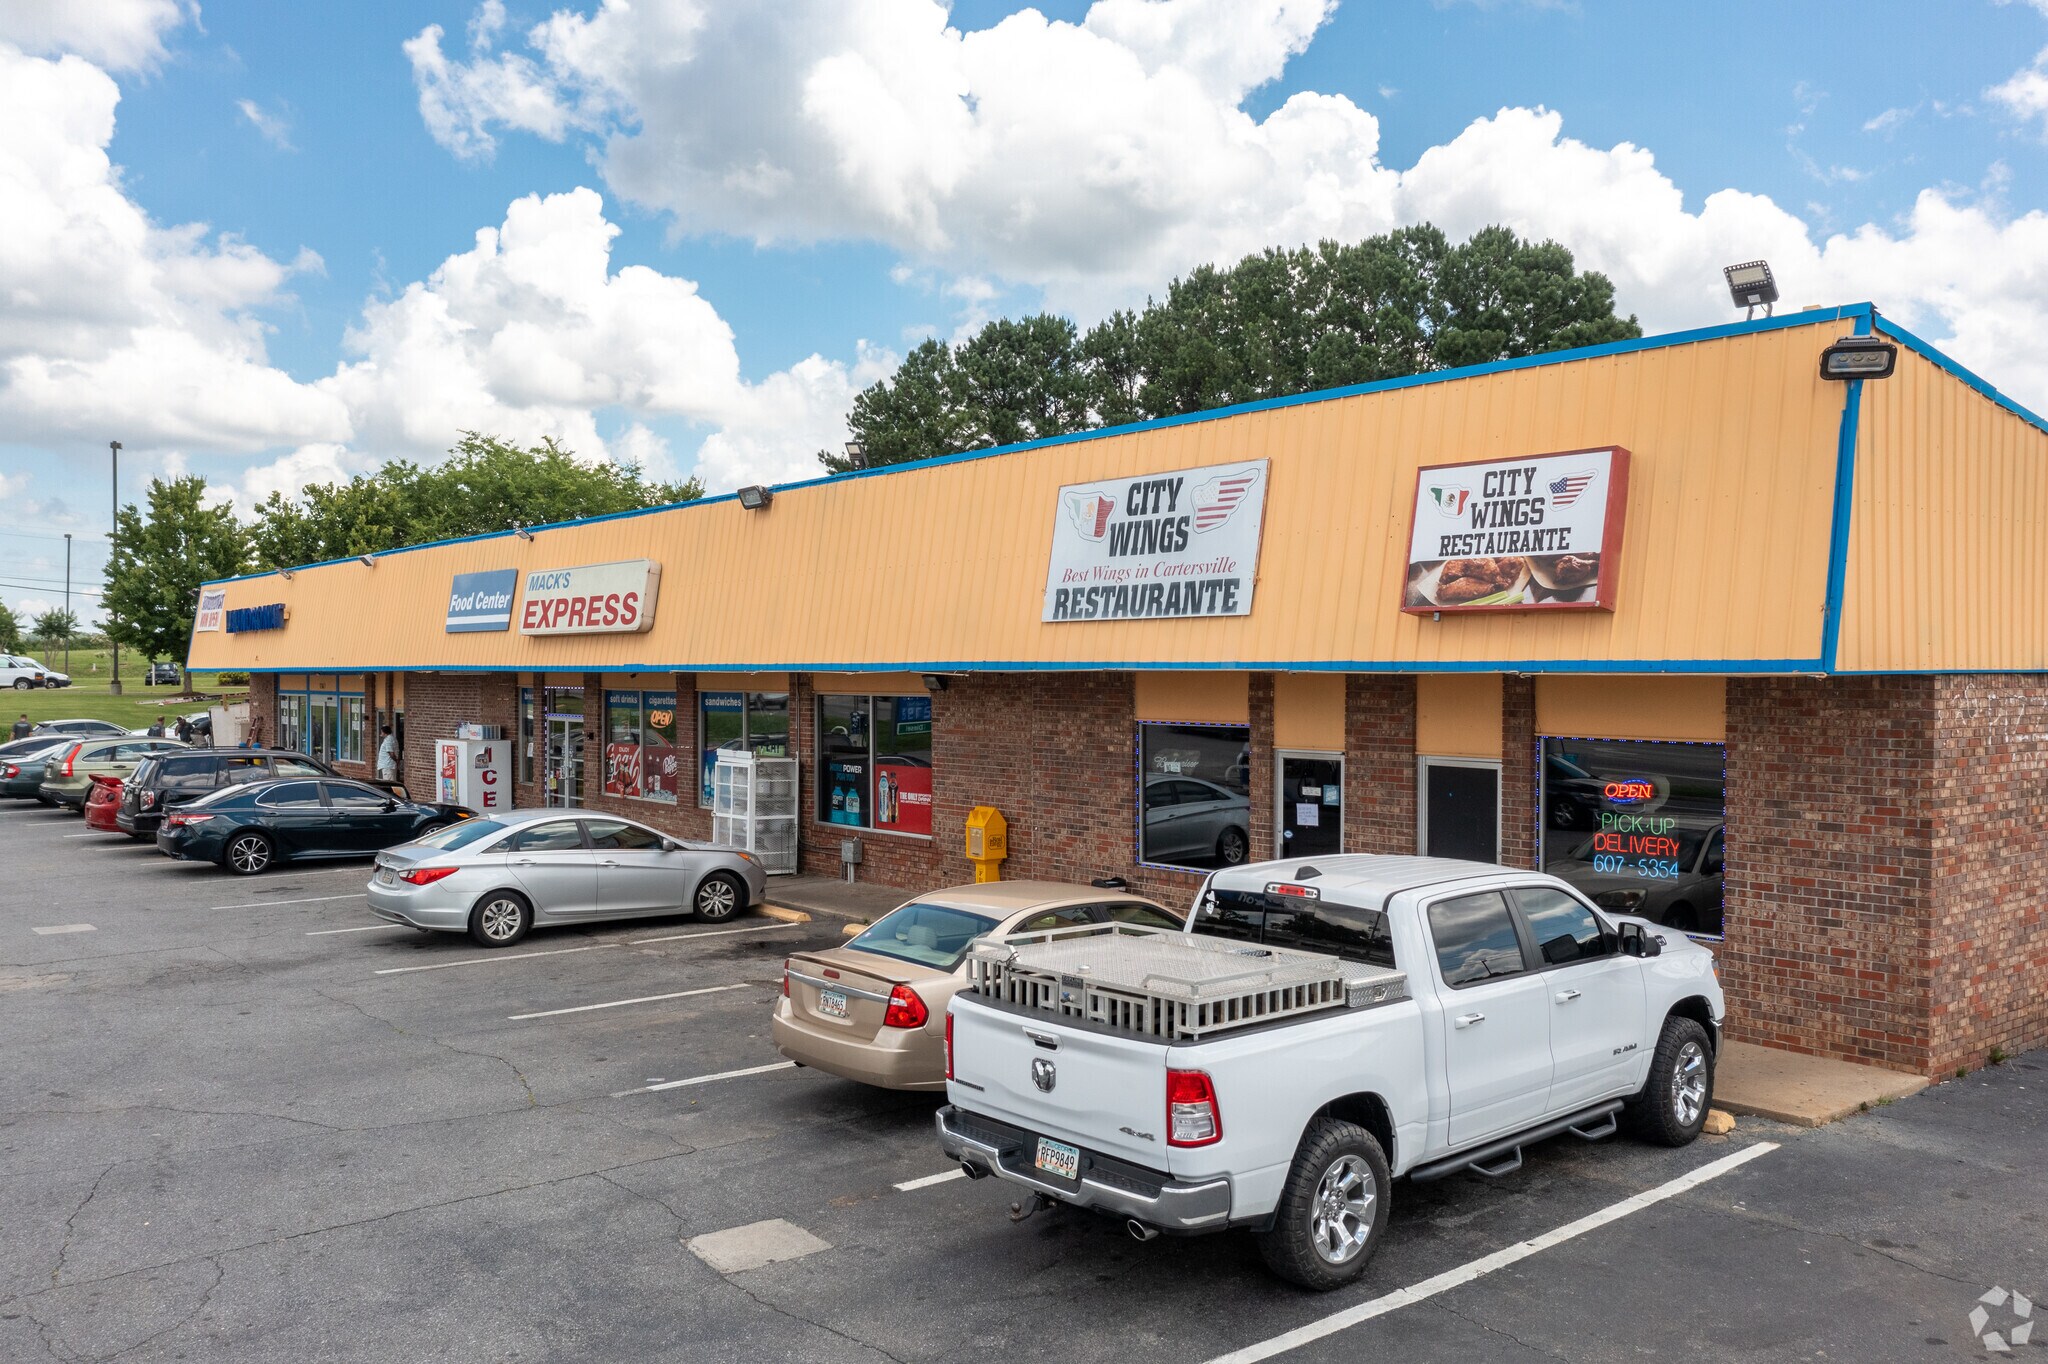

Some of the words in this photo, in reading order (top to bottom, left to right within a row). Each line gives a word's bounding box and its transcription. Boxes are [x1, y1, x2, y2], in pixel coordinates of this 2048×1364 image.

[1482, 467, 1537, 499] CITY
[1126, 477, 1184, 517] CITY
[1470, 497, 1546, 529] WINGS
[1108, 515, 1191, 558] WINGS
[1438, 526, 1572, 557] RESTAURANTE
[528, 571, 571, 592] MACK'S
[1062, 567, 1089, 583] Best
[1093, 565, 1132, 584] Wings
[1135, 563, 1149, 578] in
[1153, 556, 1237, 578] Cartersville
[450, 593, 473, 612] Food
[475, 590, 512, 610] Center
[522, 591, 639, 629] EXPRESS
[1052, 577, 1241, 620] RESTAURANTE
[609, 695, 620, 703] soft
[621, 695, 638, 704] drinks
[649, 696, 677, 706] cigarettes
[704, 697, 742, 707] sandwiches
[651, 710, 671, 727] OPEN
[842, 763, 862, 774] POWER
[1604, 782, 1653, 799] OPEN
[1593, 832, 1680, 857] DELIVERY
[1613, 1043, 1637, 1056] RAM
[1040, 1146, 1075, 1170] RFP9849
